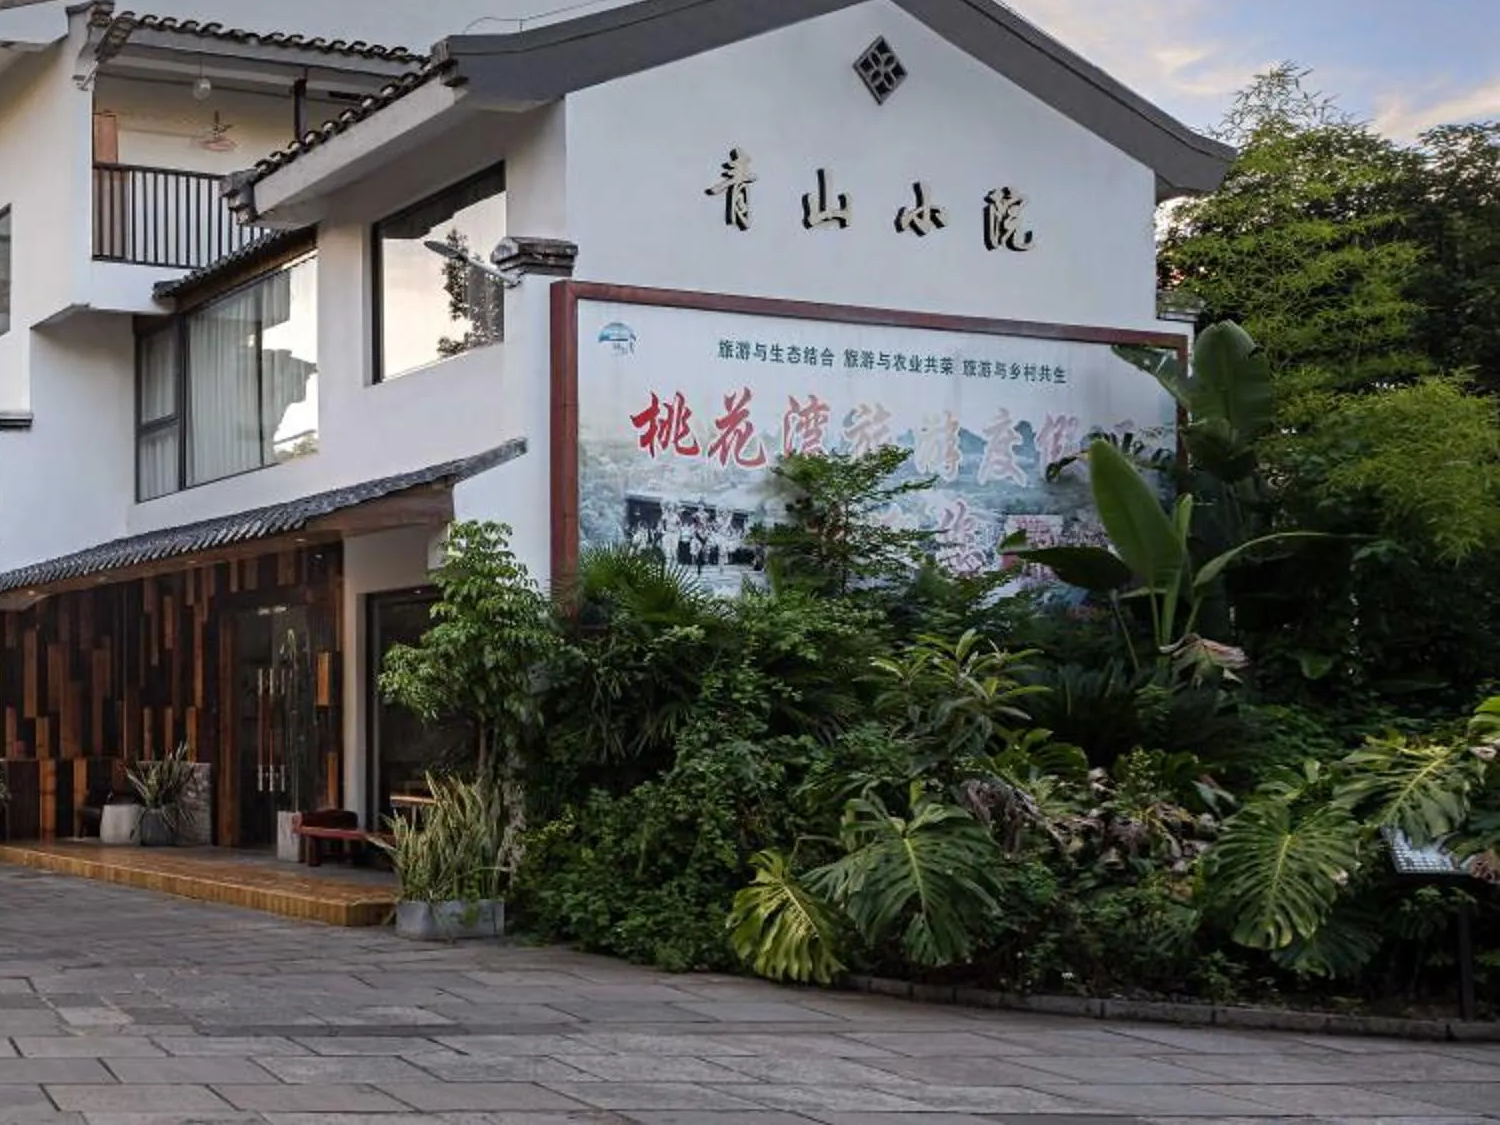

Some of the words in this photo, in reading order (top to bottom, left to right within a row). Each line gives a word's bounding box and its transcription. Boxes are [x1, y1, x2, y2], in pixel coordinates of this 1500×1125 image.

[705, 150, 1035, 251] 青山小院
[717, 339, 835, 368] 旅游与生态结合
[842, 349, 955, 377] 旅游与农业共荣
[962, 358, 1067, 385] 旅游与乡村共生
[630, 386, 1138, 488] 桃花湾旅游度假
